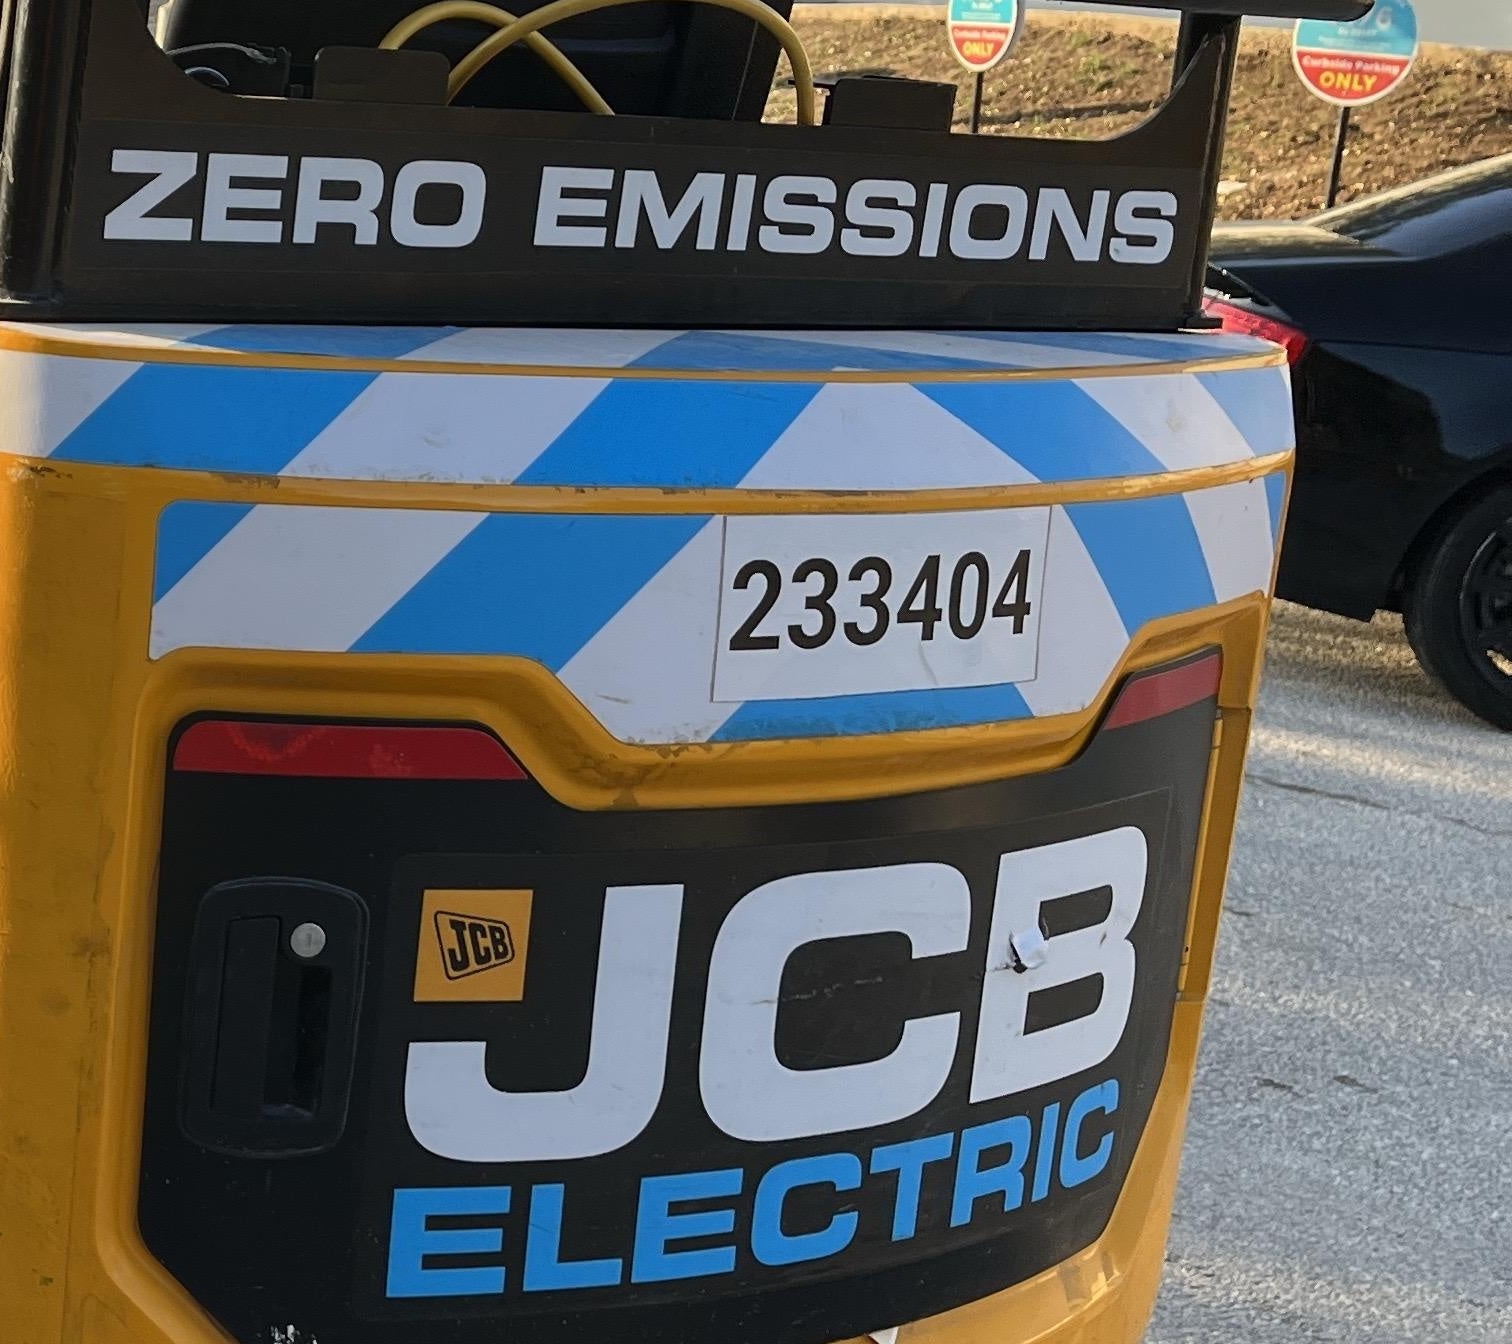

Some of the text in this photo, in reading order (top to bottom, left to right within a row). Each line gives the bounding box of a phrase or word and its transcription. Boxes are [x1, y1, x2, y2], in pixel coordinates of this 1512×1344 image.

[962, 41, 995, 57] ONLY
[1319, 70, 1378, 92] ONLY
[103, 149, 1178, 264] ZERO EMISSIONS
[728, 549, 1033, 652] 233404
[404, 825, 1149, 1163] JCB
[447, 918, 510, 972] JCB
[385, 1078, 1121, 1300] ELECTRIC
